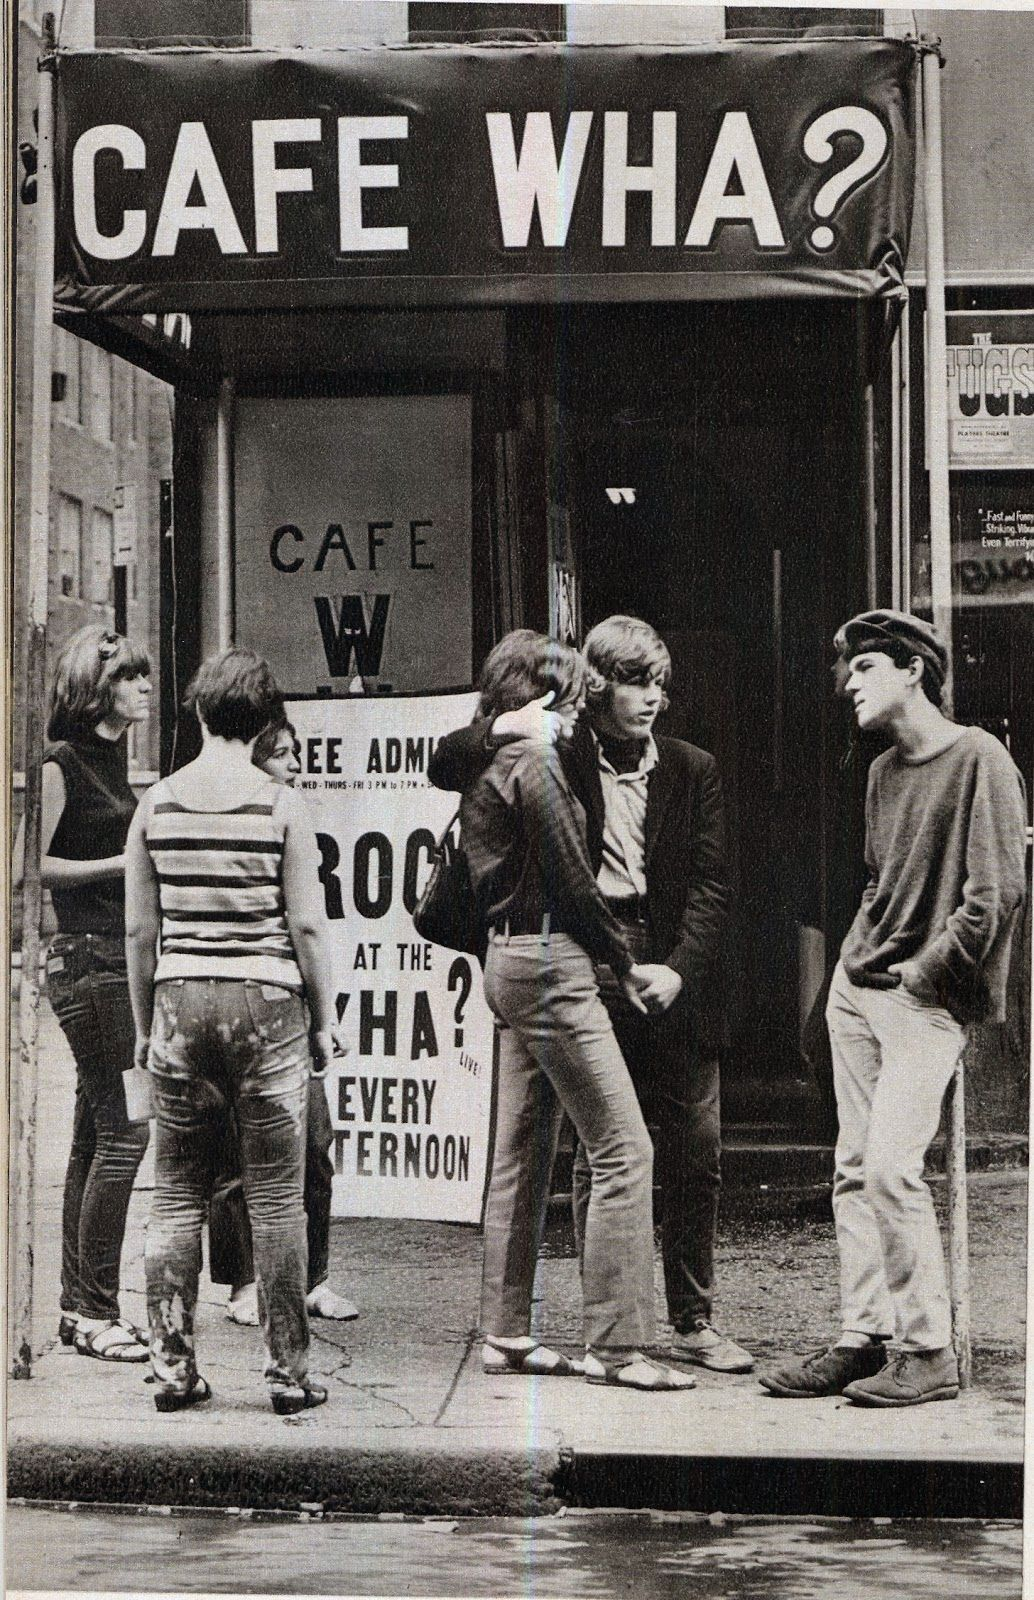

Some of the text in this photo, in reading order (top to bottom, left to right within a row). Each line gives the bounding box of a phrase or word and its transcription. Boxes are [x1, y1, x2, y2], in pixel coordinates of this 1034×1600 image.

[72, 105, 888, 260] CAFE WHA?
[269, 520, 434, 573] CAFE
[353, 943, 433, 971] AT THE
[338, 1076, 437, 1125] EVERY
